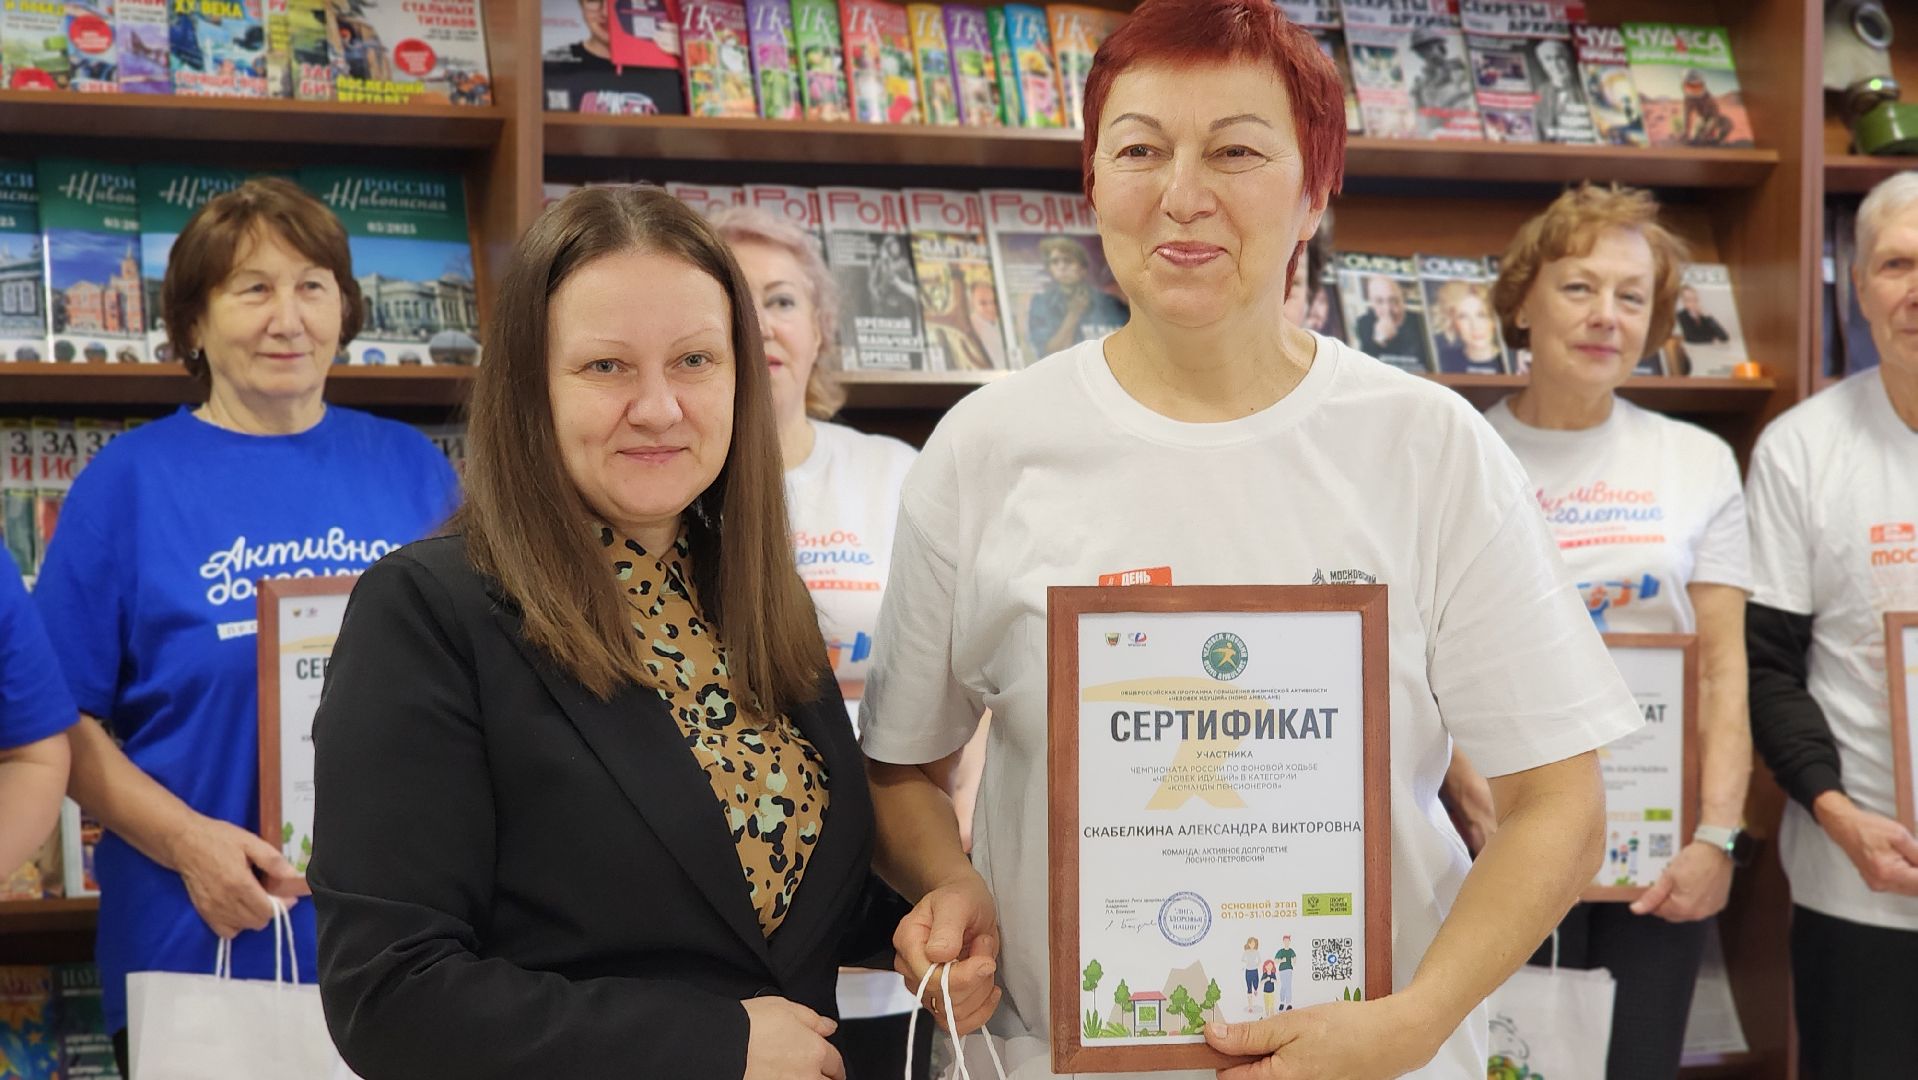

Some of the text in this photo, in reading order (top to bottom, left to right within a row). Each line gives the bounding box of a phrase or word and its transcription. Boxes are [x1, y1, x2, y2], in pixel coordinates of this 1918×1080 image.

[1121, 570, 1151, 586] ДЕНЬ
[1110, 707, 1339, 743] СЕРТИФИКАТ
[1196, 750, 1254, 759] УЧАСТНИКА
[1130, 762, 1318, 775] ЧЕМПИОНАТА РОССИИ ПО ФОНОВОЙ ХОДЬБЕ
[1152, 774, 1196, 783] «ЧЕЛОВЕК
[1240, 773, 1247, 781] В
[1248, 773, 1297, 781] КАТЕГОРИИ
[1167, 783, 1215, 792] «КОМАНДЫ
[1083, 820, 1362, 838] СКАБЕЛКИНА АЛЕКСАНДРА ВИКТОРОВНА
[1202, 847, 1240, 856] АКТИВНОЕ
[1241, 845, 1288, 855] ДОЛГОЛЕТИЕ
